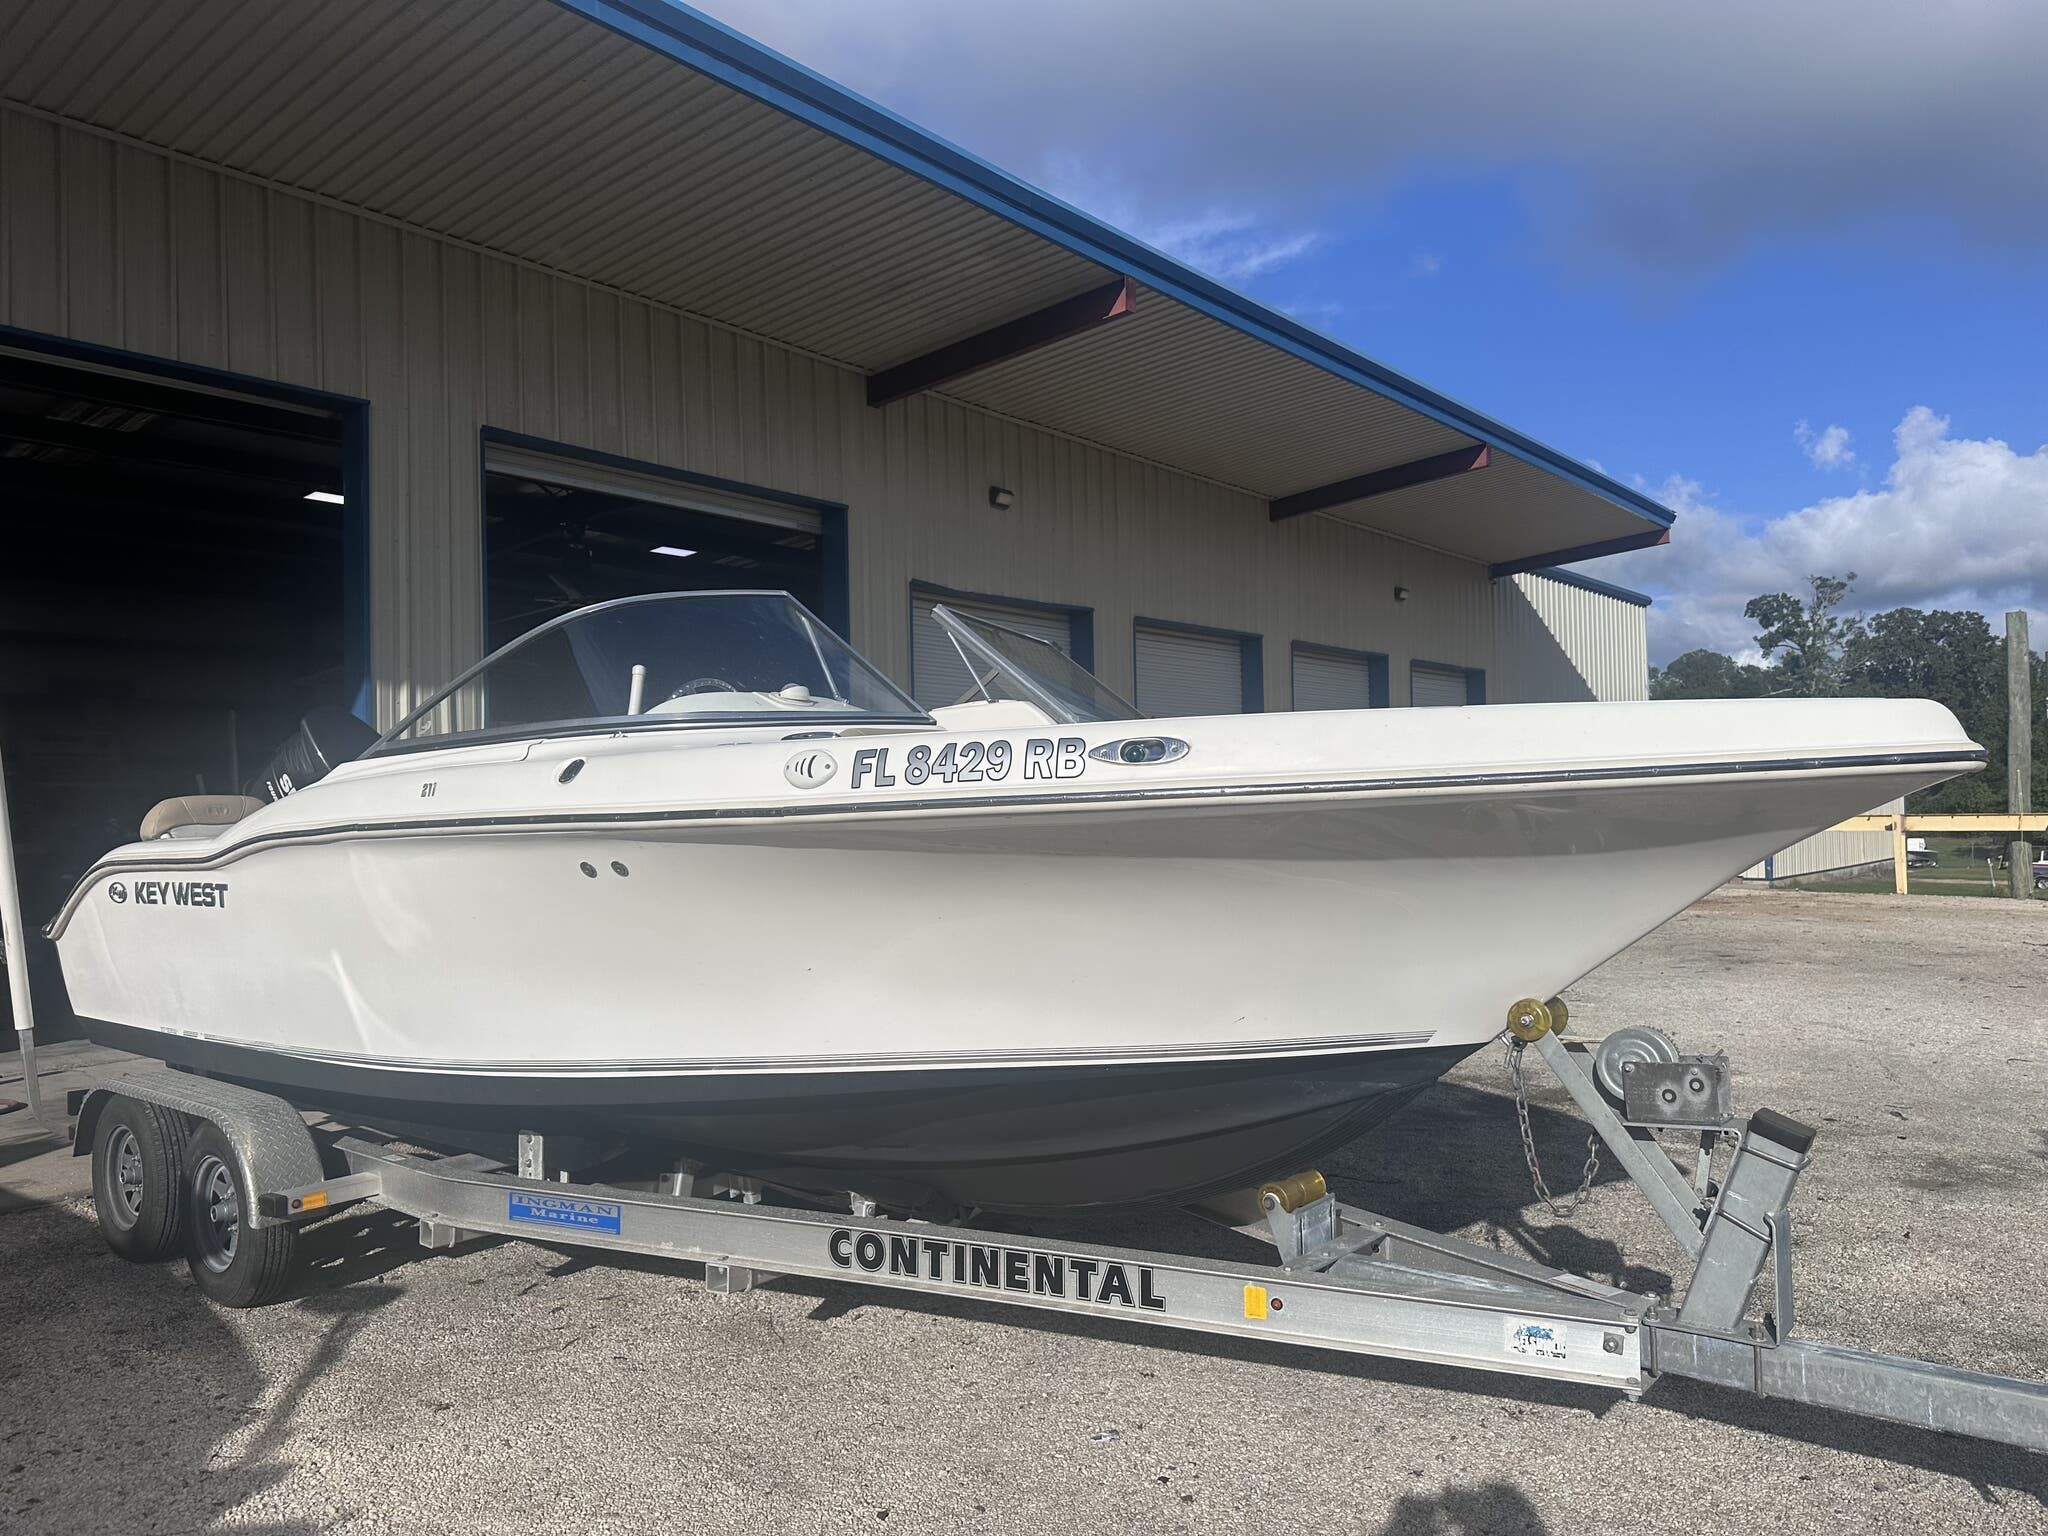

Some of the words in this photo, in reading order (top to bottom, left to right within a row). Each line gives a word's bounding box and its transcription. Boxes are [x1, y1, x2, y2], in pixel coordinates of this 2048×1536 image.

[851, 747, 896, 789] FL
[904, 739, 1013, 786] 8429
[1024, 737, 1087, 780] RB
[134, 881, 170, 905] KEY
[171, 881, 229, 908] WEST
[516, 1194, 613, 1216] INGMAN
[530, 1207, 599, 1224] Marine
[828, 1227, 1166, 1312] CONTINENTAL
